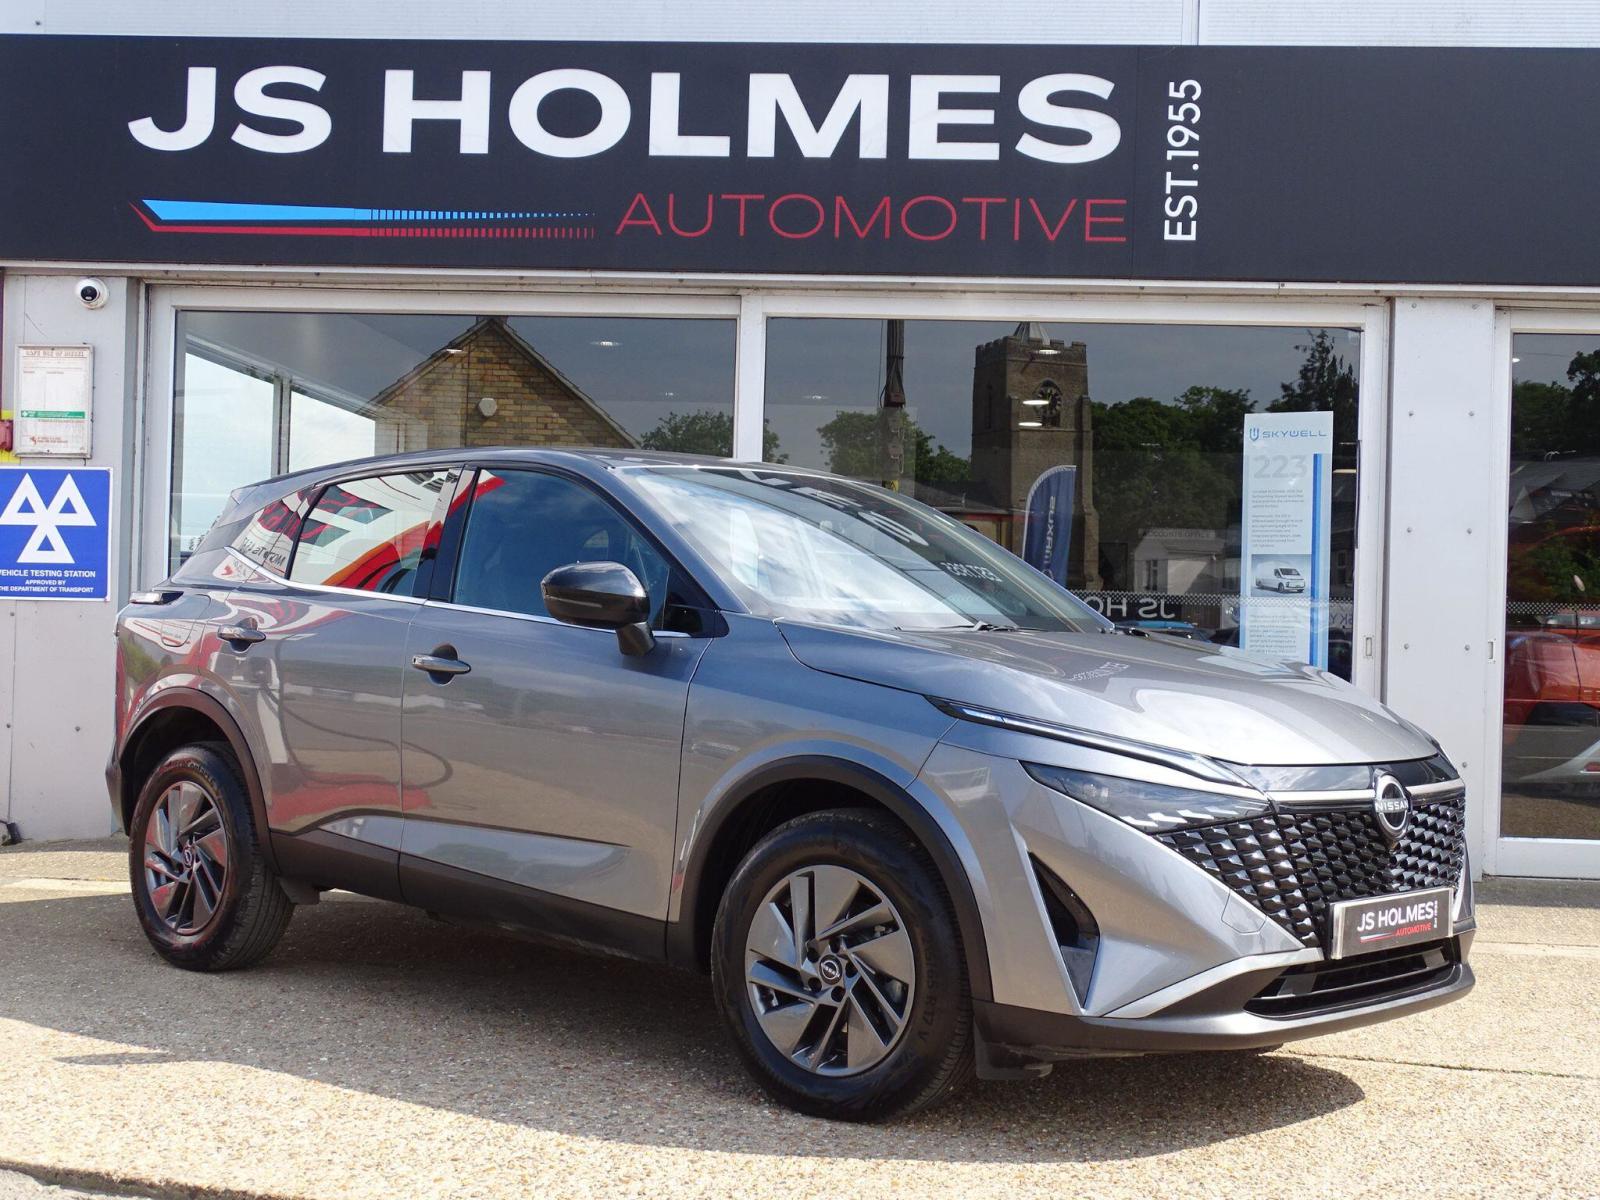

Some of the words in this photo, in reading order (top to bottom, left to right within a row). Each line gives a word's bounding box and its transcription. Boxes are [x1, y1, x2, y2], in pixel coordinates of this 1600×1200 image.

[128, 66, 332, 153] JS
[382, 68, 1122, 164] HOLMES
[1164, 79, 1202, 242] EST.1955
[616, 192, 1126, 243] AUTOMOTIVE
[1262, 429, 1327, 439] SKYWELL
[1253, 454, 1308, 479] 223
[30, 569, 62, 577] TESTING
[64, 570, 96, 578] STATION
[1375, 800, 1409, 811] NISSAN
[1357, 911, 1375, 932] JS
[1378, 901, 1434, 928] HOLMES
[1396, 923, 1432, 936] AUTOMOTIVE
